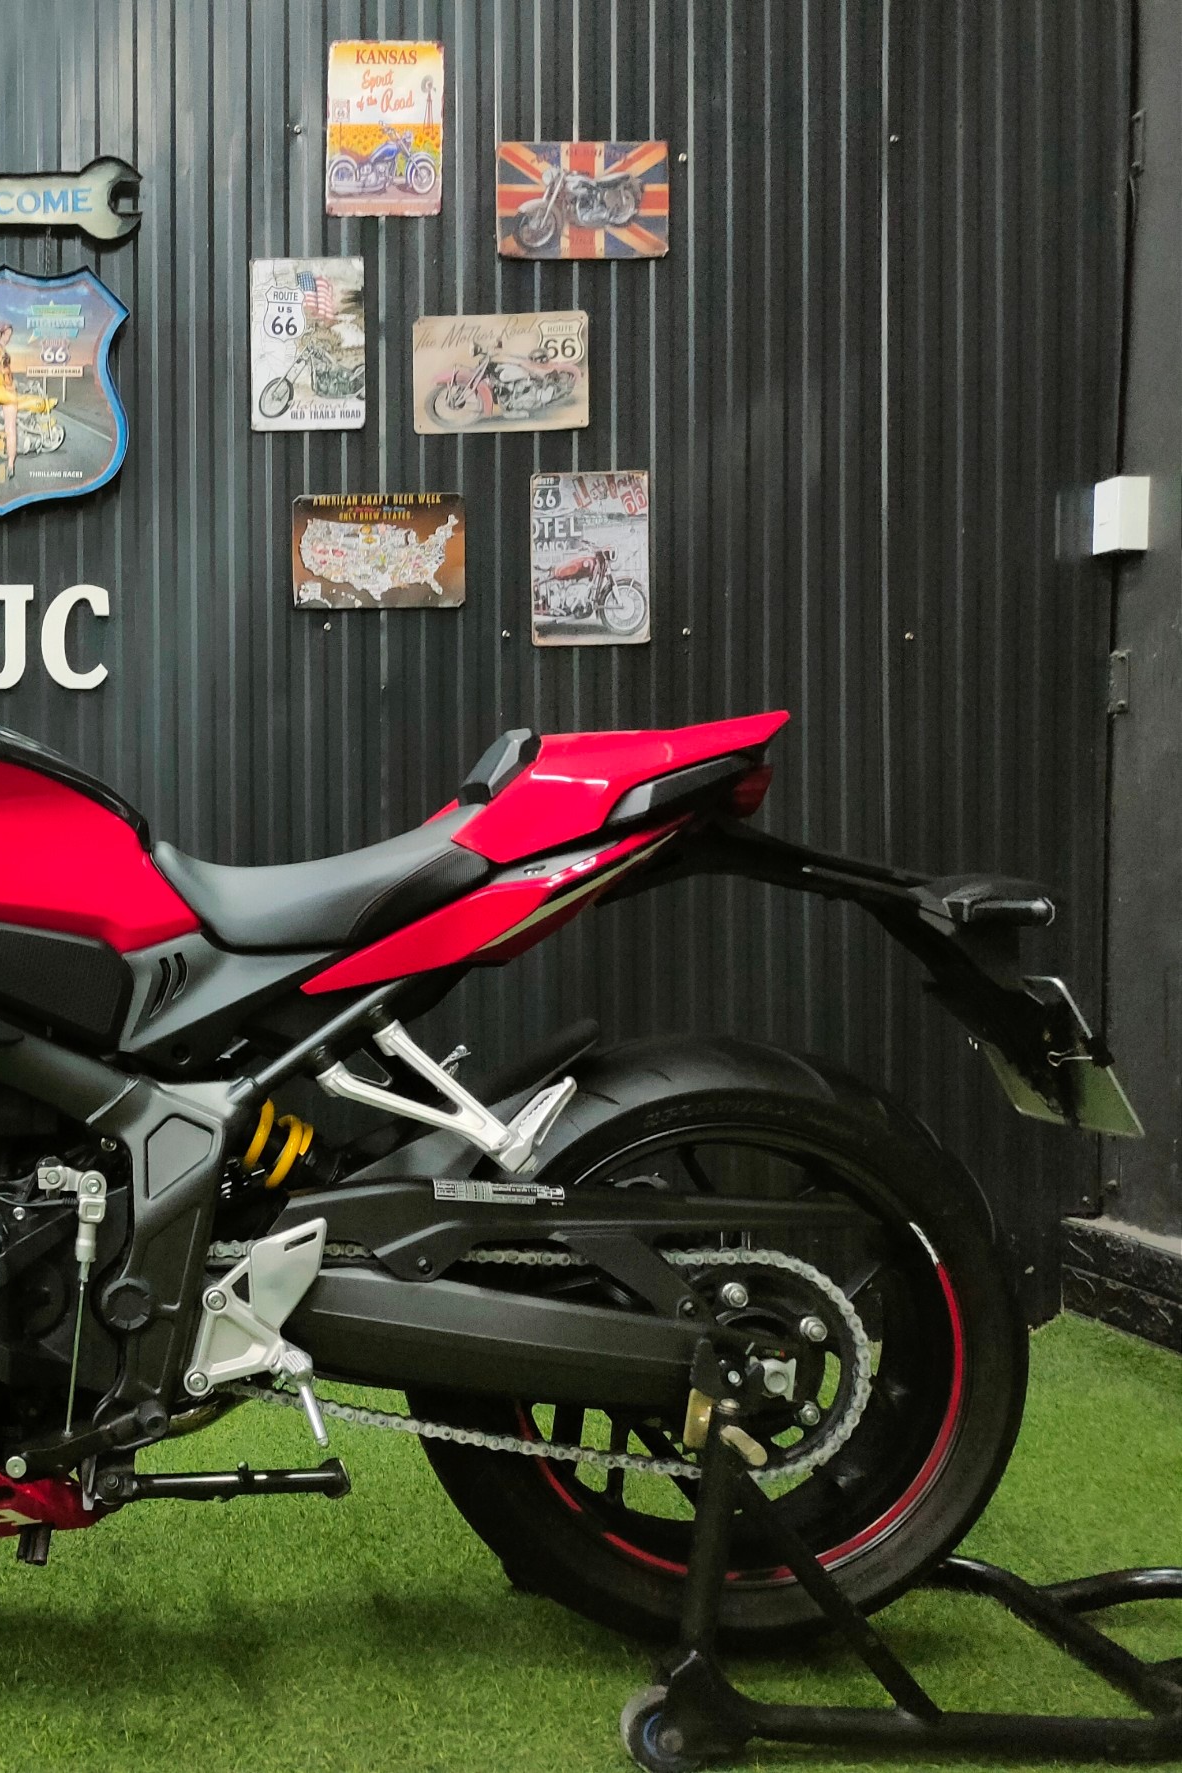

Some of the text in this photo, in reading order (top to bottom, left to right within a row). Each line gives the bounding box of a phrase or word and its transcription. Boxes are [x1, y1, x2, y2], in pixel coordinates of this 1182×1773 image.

[355, 49, 418, 65] KANSAS
[362, 69, 395, 92] Spirit
[356, 96, 365, 112] of
[366, 95, 378, 107] the
[380, 88, 415, 113] Road
[273, 291, 298, 301] ROUTE
[271, 316, 298, 336] 66
[415, 315, 538, 352] The Mother Road
[548, 324, 573, 333] ROUTE
[43, 347, 66, 362] 66
[544, 338, 576, 359] 66
[290, 400, 348, 411] National
[291, 409, 362, 420] OLD TRAILS ROAD
[313, 494, 442, 507] AMERICAN CRAFT BEER WEEK
[533, 489, 556, 508] 66
